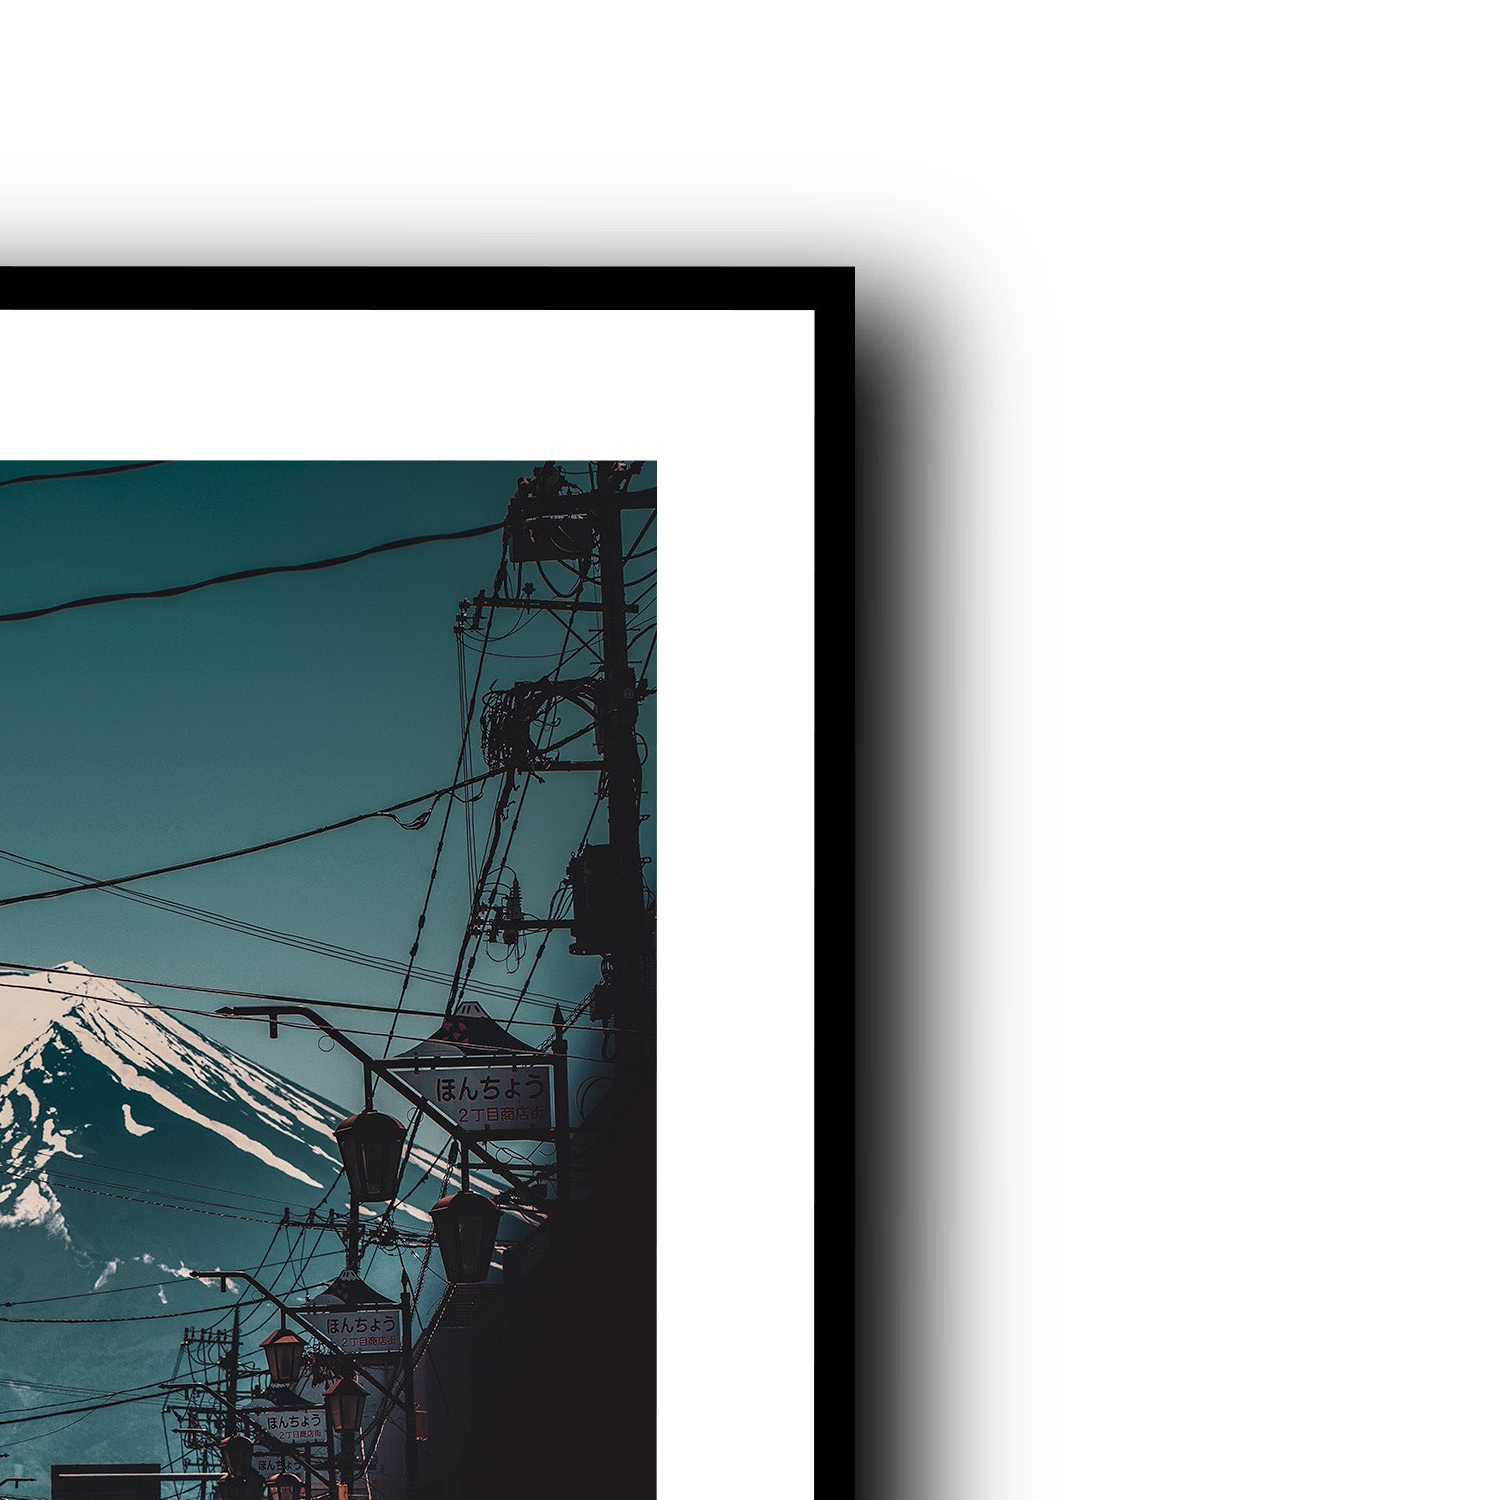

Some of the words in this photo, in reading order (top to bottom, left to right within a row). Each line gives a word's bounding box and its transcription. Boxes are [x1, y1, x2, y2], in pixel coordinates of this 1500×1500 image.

[436, 1074, 544, 1102] ほんちょう
[326, 1315, 396, 1334] ほんちょう
[267, 1414, 321, 1430] ほんちょう
